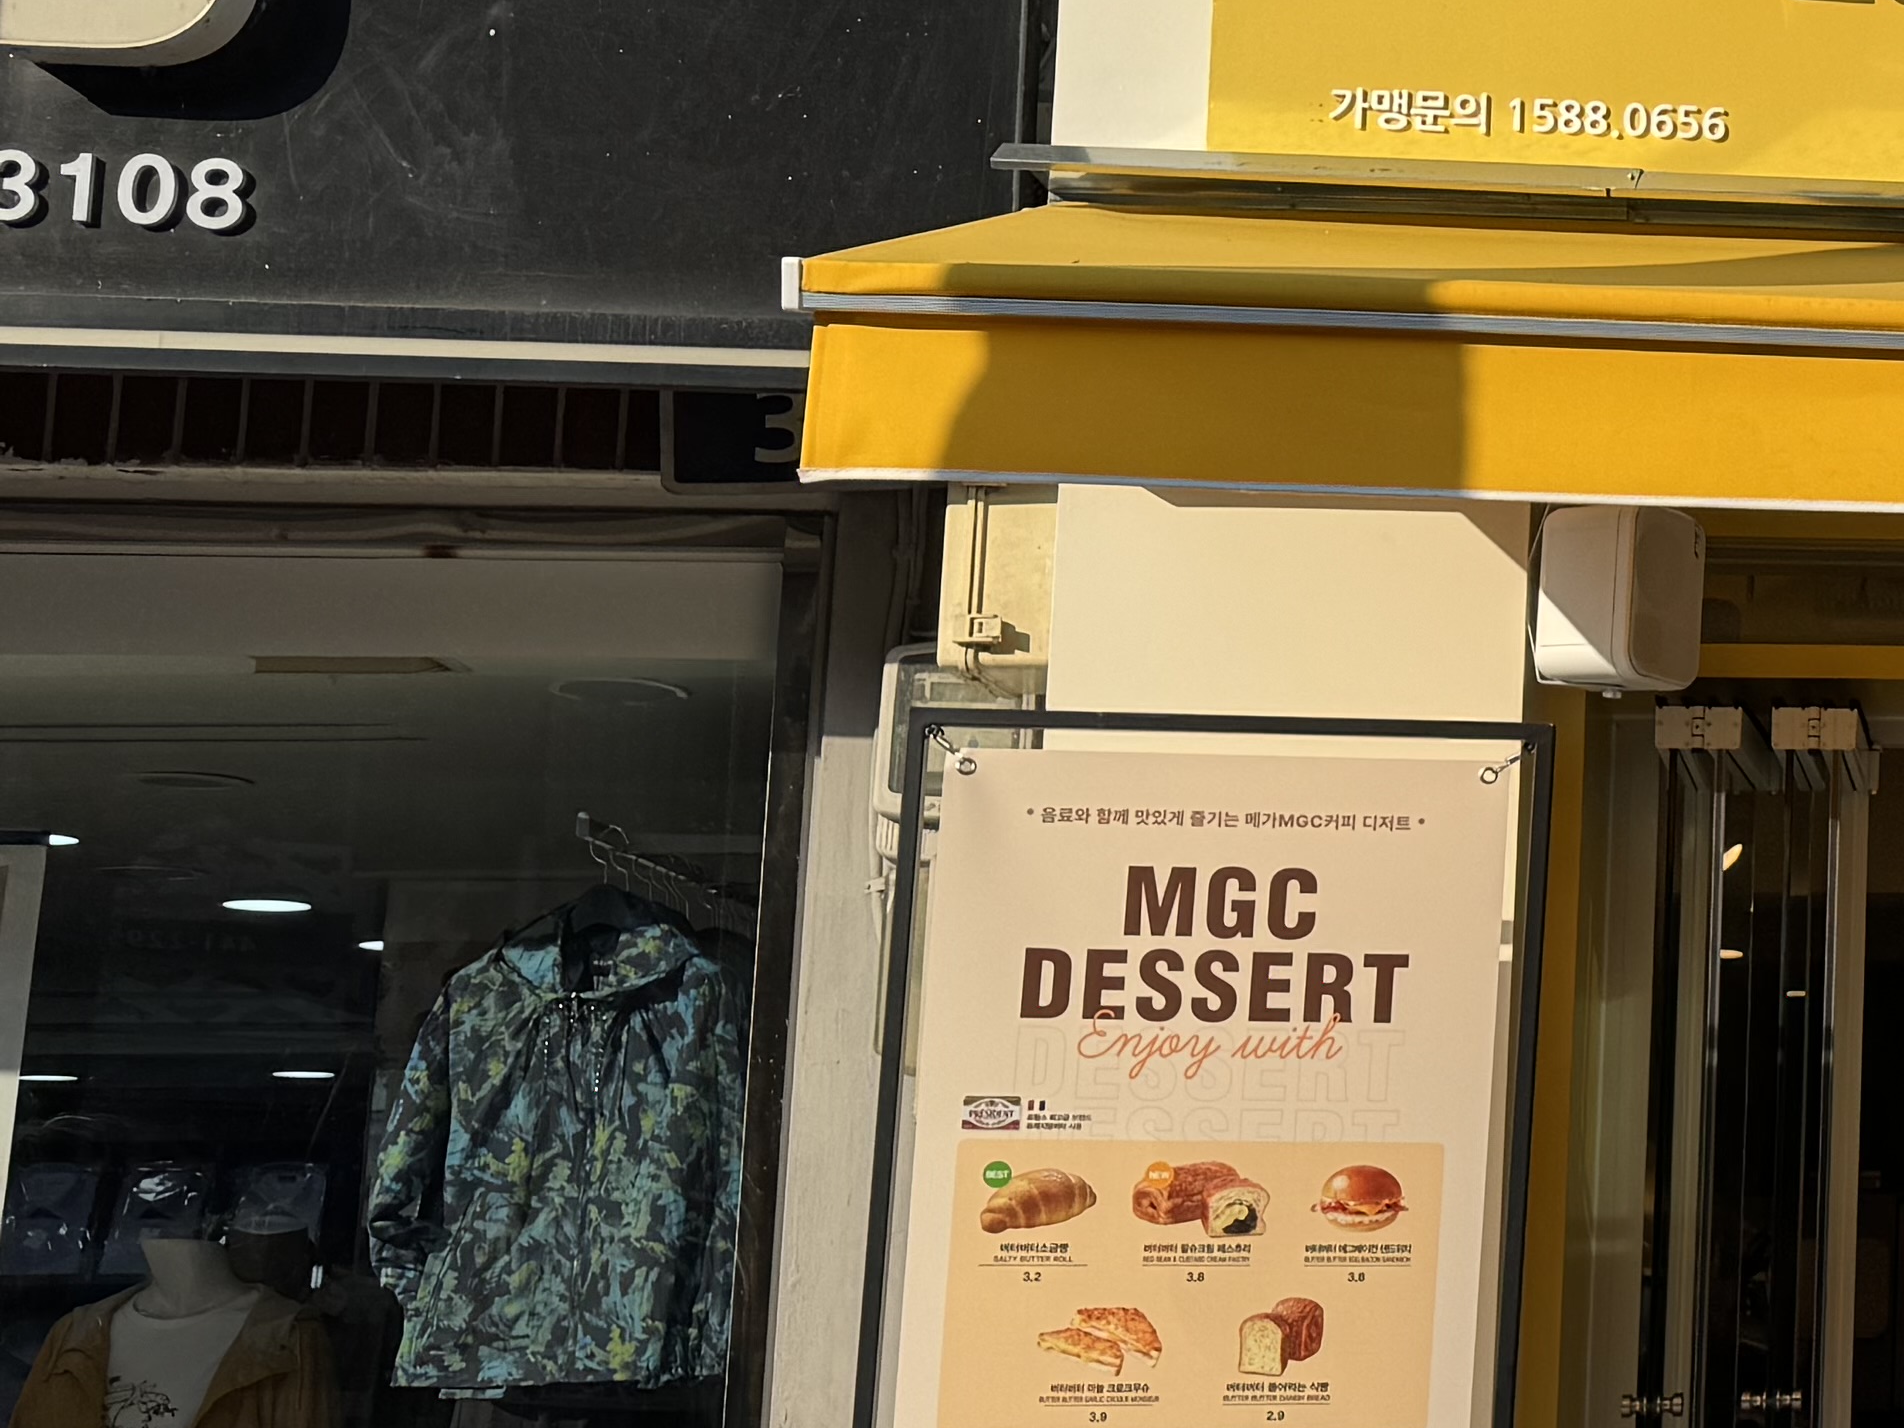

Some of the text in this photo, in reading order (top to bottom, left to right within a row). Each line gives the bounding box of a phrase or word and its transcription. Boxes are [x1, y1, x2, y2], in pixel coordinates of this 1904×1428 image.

[1329, 87, 1730, 144] 가맹문의 1588.0656
[0, 148, 253, 234] 3108
[1040, 806, 1412, 833] 음료와 함께 맛있게 즐기는 메가MGC커피 디저트
[1122, 864, 1319, 942] MGC
[1018, 946, 1410, 1024] DESSERT
[1077, 1008, 1346, 1080] Enjoy with
[985, 1169, 1010, 1179] BEST
[1149, 1170, 1171, 1180] NEW
[1022, 1271, 1042, 1283] 3.2
[1186, 1271, 1205, 1283] 3.8
